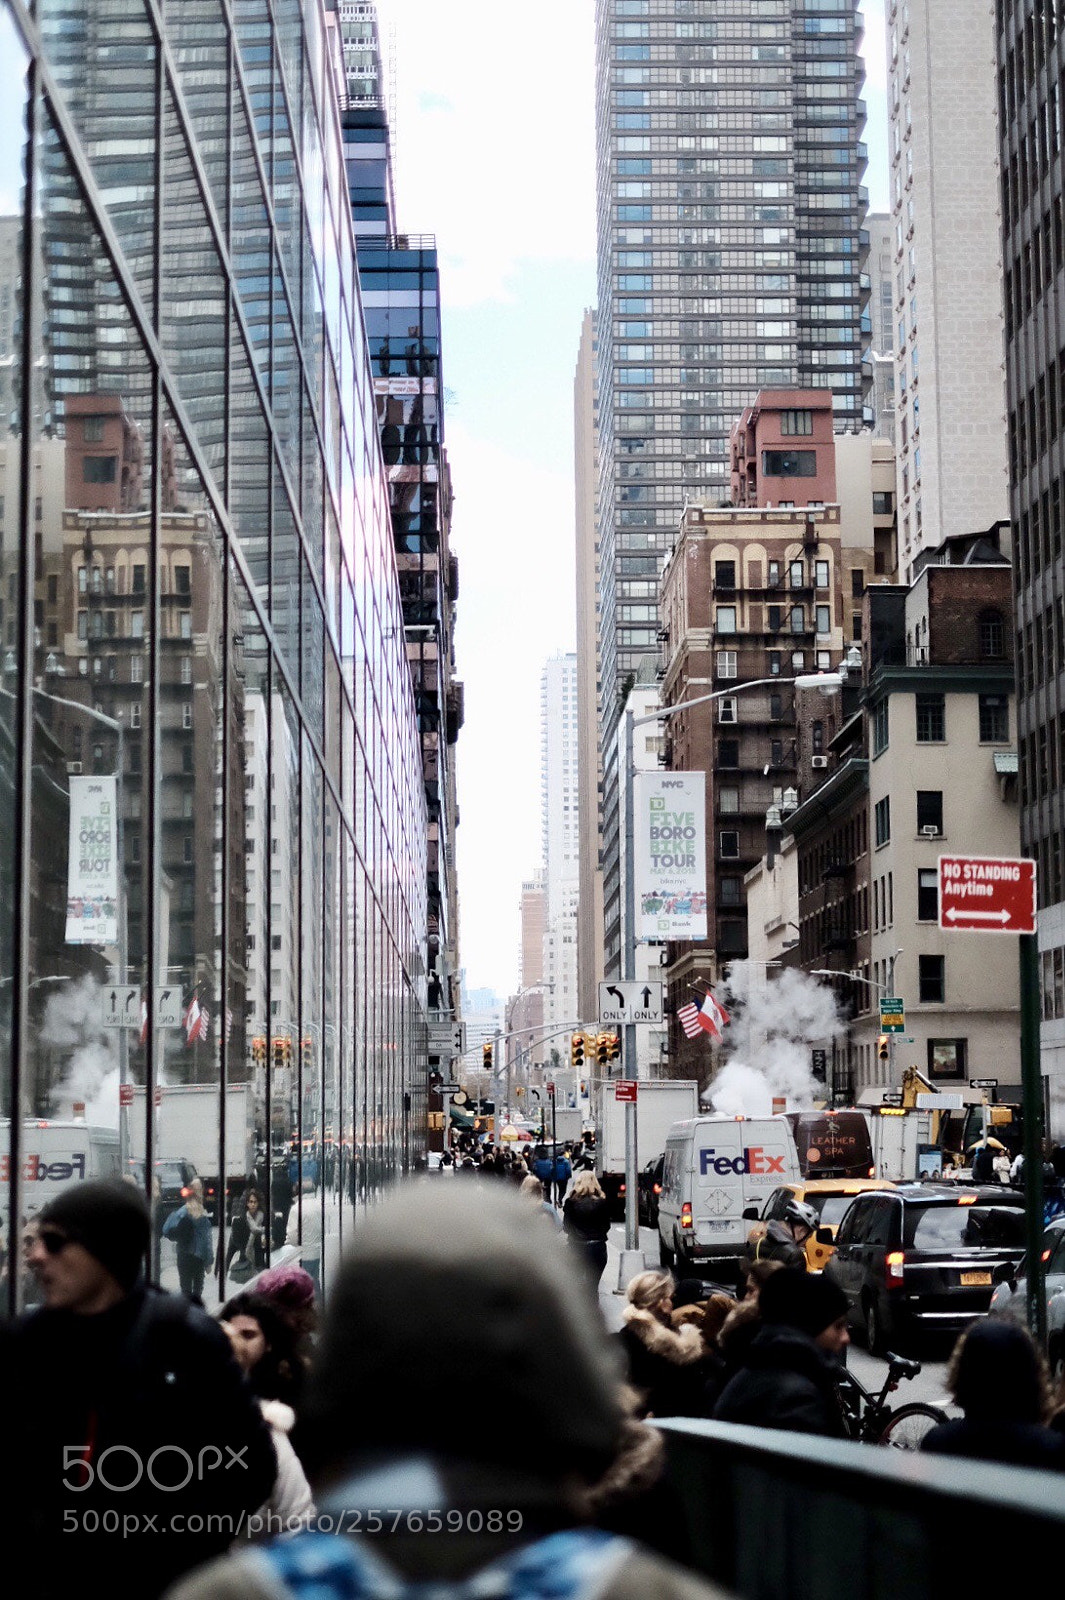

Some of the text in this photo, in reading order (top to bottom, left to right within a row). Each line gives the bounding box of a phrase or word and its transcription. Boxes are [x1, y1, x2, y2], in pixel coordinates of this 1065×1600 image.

[661, 780, 684, 789] NYC
[650, 812, 695, 826] FIVE
[650, 826, 696, 840] BORO
[650, 840, 695, 854] BIKE
[650, 854, 696, 868] TOUR
[943, 863, 1021, 881] NO STANDING
[944, 880, 994, 898] Anytime
[602, 1011, 627, 1020] ONLY
[634, 1010, 659, 1020] ONLY
[811, 1136, 856, 1146] LEATHER
[824, 1146, 844, 1156] SPA
[699, 1147, 786, 1175] FedEx
[749, 1175, 784, 1184] Express
